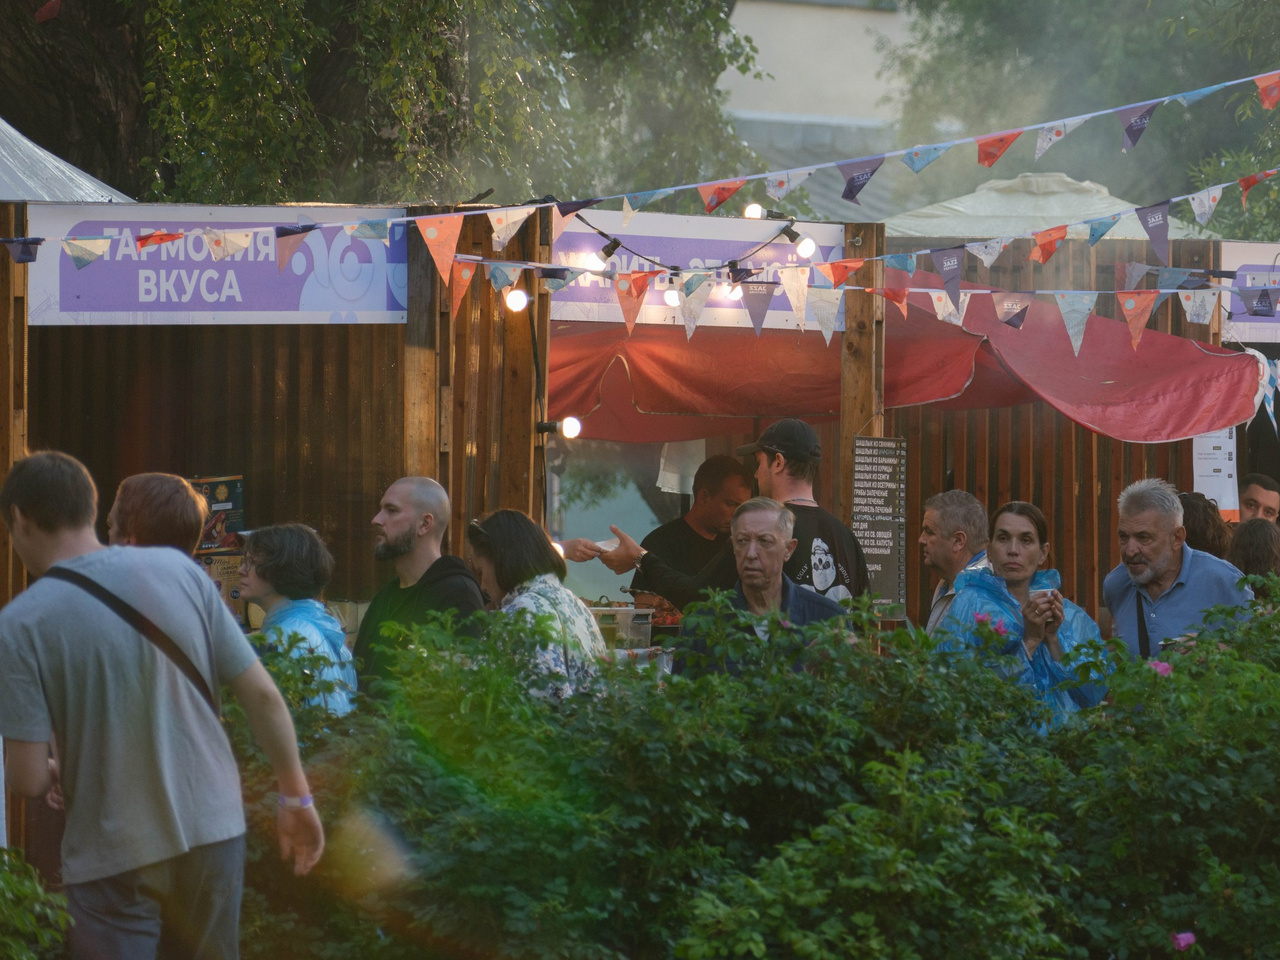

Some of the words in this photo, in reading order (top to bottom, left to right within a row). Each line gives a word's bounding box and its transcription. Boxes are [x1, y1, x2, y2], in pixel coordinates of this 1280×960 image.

[943, 259, 958, 268] JAZZ
[138, 269, 243, 303] ВКУСА
[796, 563, 808, 580] UGLY
